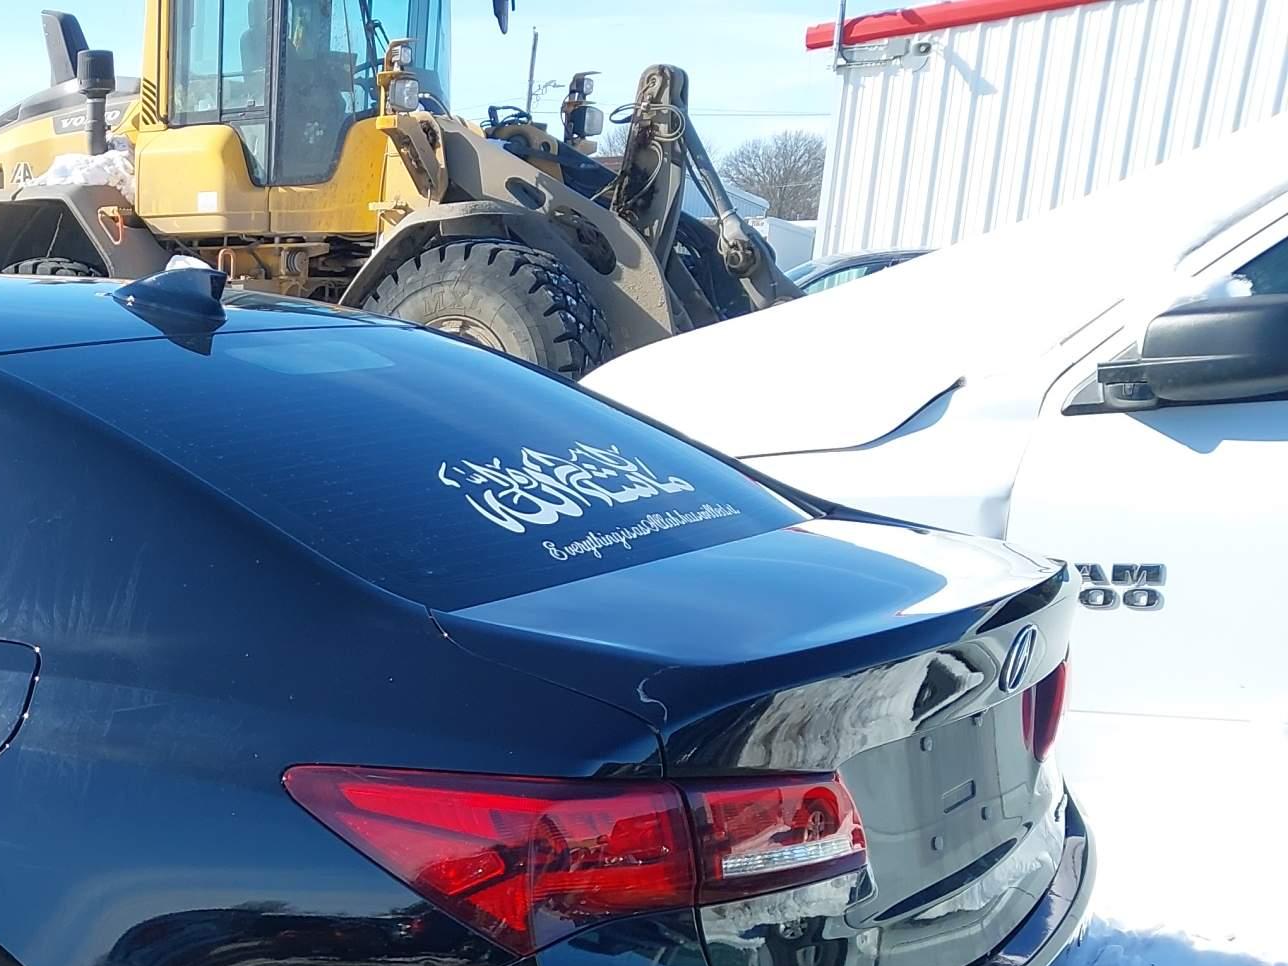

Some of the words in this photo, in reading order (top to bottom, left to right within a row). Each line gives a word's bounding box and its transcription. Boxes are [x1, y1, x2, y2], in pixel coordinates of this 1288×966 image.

[542, 530, 631, 561] Everything
[1074, 563, 1166, 586] AM
[1078, 588, 1166, 612] 00
